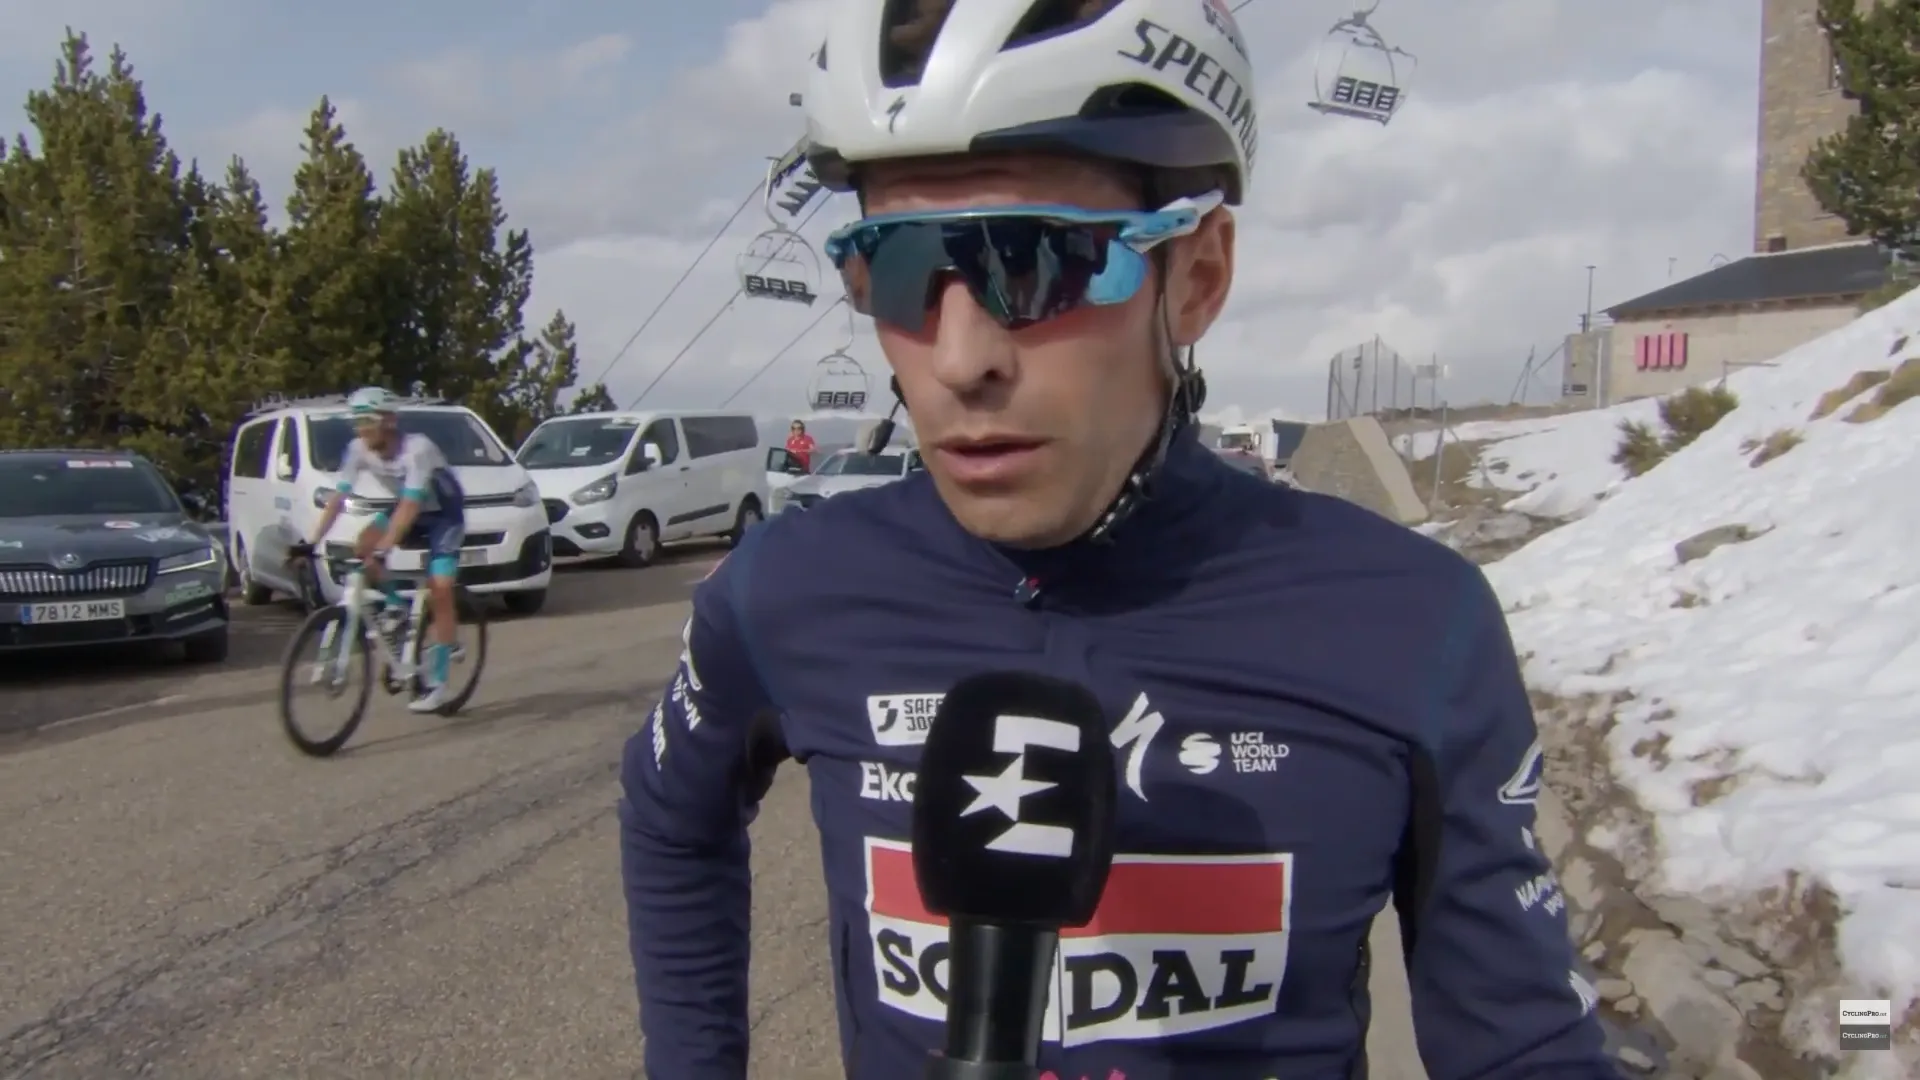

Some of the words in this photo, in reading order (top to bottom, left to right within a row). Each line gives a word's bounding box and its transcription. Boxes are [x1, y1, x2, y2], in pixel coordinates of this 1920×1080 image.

[36, 606, 81, 621] 7812
[88, 602, 120, 617] MMS
[1231, 731, 1264, 744] UCI
[1231, 744, 1290, 758] WORLD
[1233, 759, 1277, 773] TEAM
